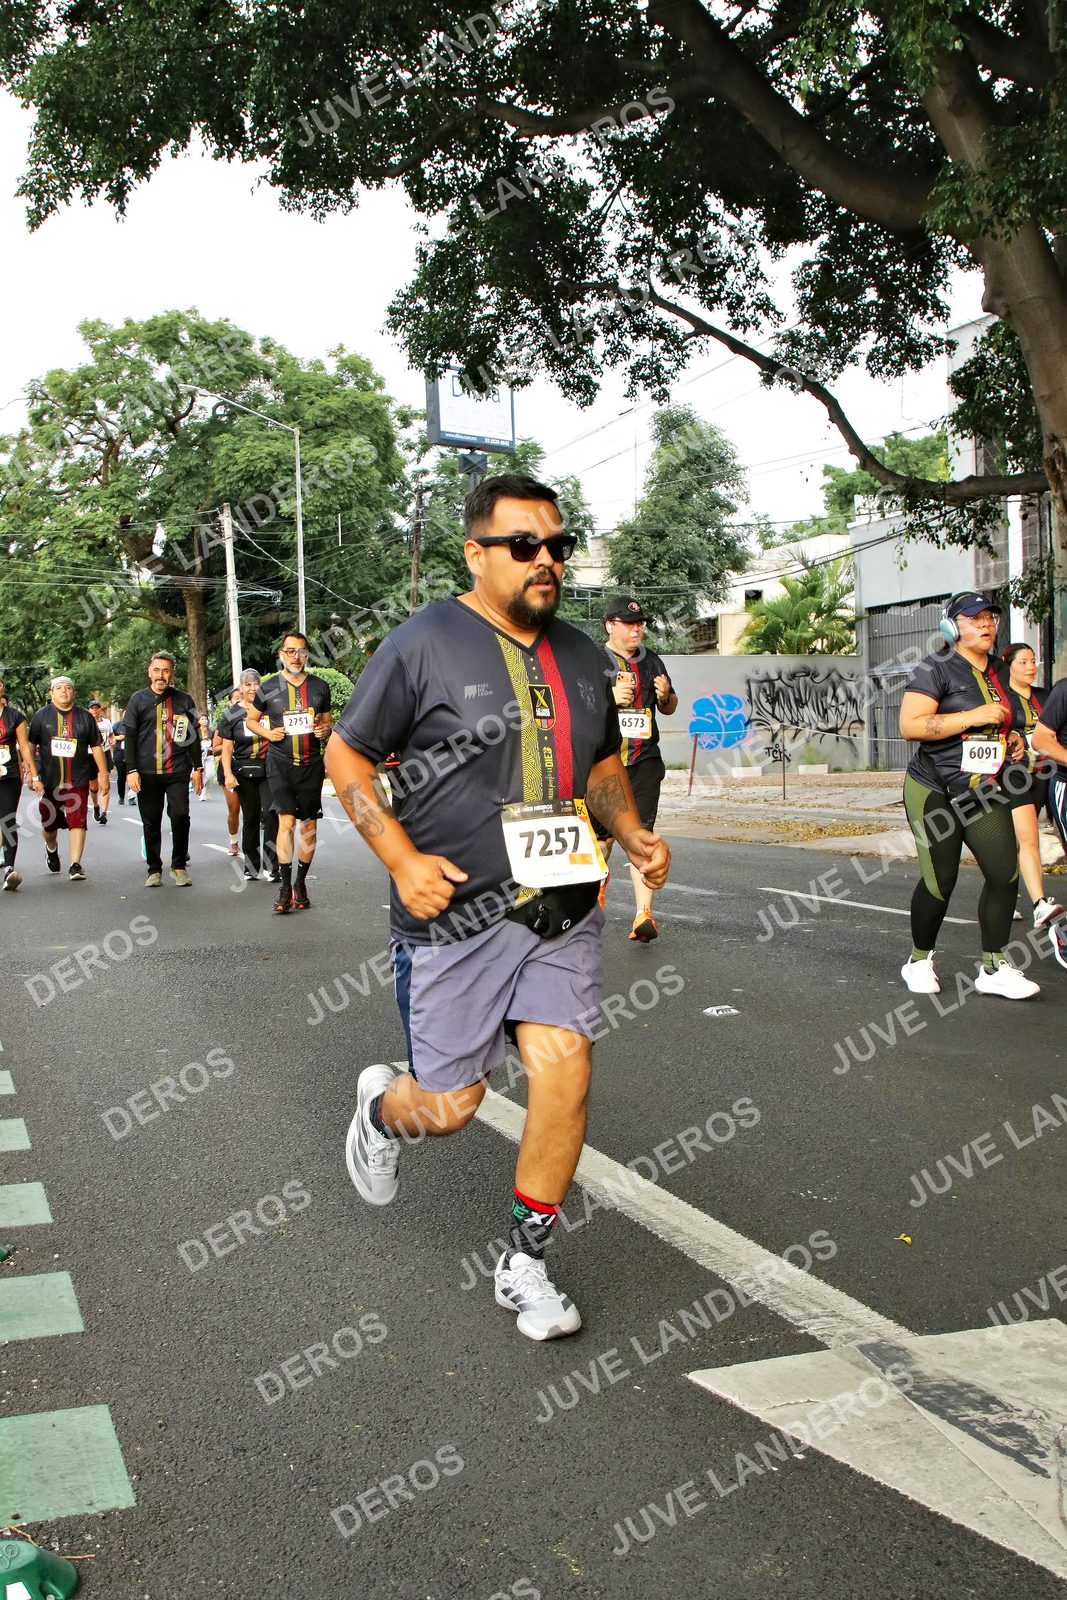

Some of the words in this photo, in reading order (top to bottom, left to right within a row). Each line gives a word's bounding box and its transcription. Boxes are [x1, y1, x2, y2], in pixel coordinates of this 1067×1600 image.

[288, 717, 309, 727] 2751
[621, 717, 645, 728] 6573
[54, 742, 71, 750] 4526
[969, 746, 998, 759] 6091
[519, 826, 580, 858] 7257
